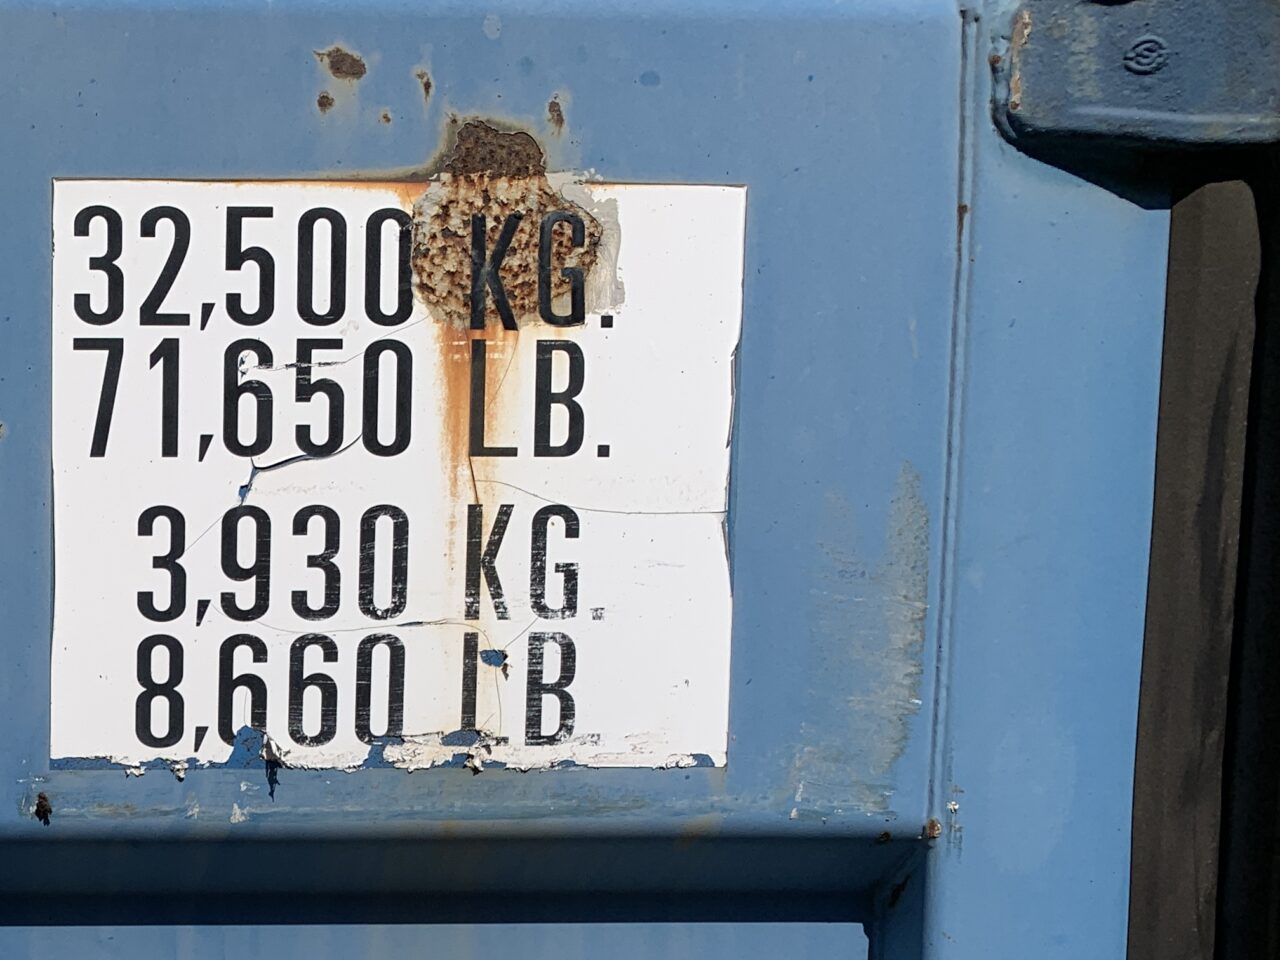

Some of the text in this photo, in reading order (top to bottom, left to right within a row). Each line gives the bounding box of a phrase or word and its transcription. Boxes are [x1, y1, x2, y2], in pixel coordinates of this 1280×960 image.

[73, 205, 614, 331] 32,500 KG.
[72, 338, 612, 462] 71,650 LB.
[136, 504, 605, 627] 3,930 KG.
[134, 632, 407, 752] 8,660
